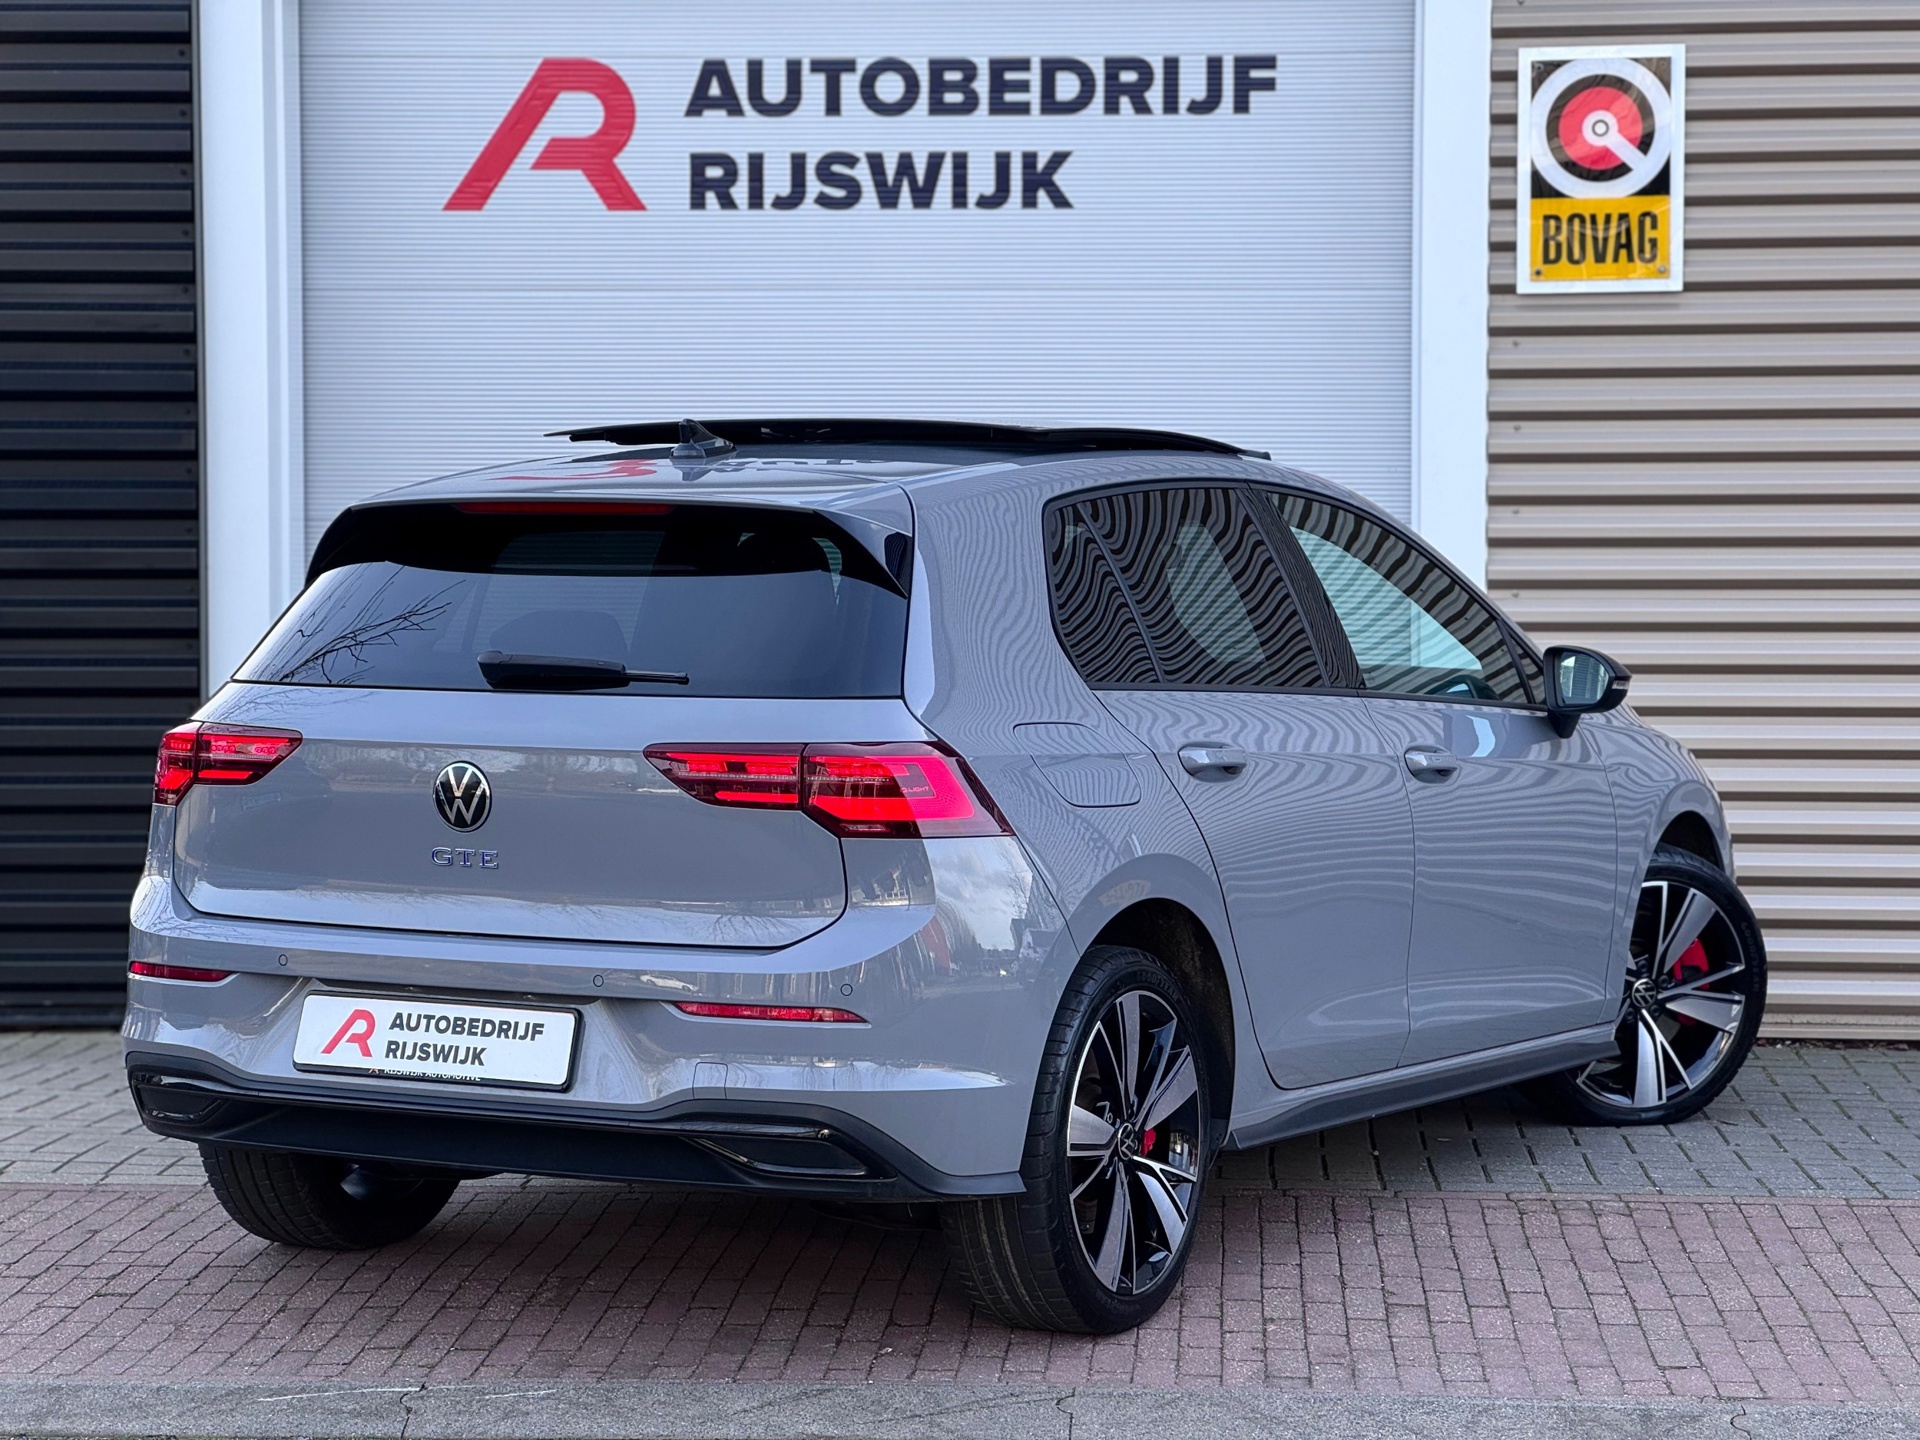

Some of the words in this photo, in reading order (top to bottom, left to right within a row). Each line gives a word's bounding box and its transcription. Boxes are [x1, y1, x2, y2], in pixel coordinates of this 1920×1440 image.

[685, 55, 1277, 117] AUTOBEDRIJF
[689, 151, 1075, 210] RIJSWIJK
[1542, 211, 1659, 265] BOVAG
[431, 846, 499, 868] GTE
[388, 1012, 545, 1041] AUTOBEDRIJF
[384, 1040, 487, 1066] RIJSWIJK
